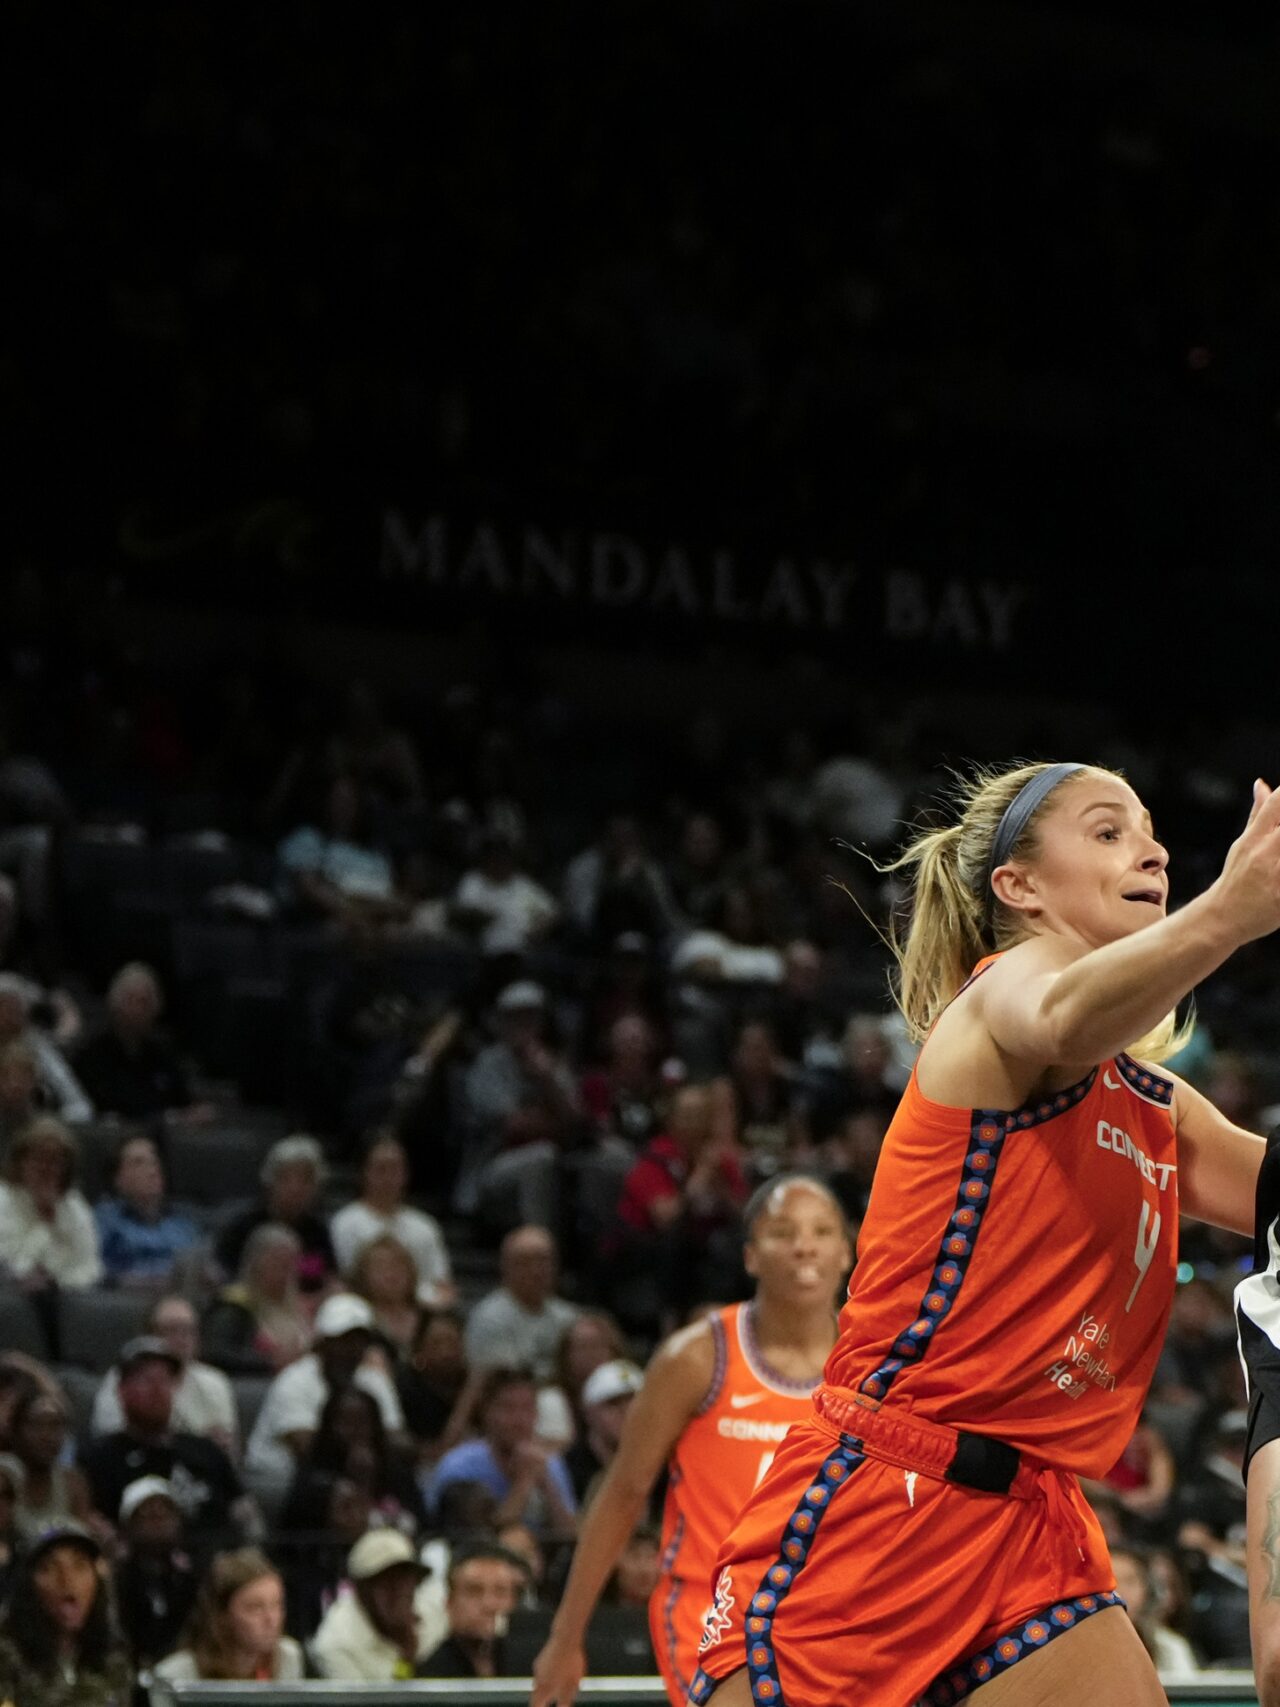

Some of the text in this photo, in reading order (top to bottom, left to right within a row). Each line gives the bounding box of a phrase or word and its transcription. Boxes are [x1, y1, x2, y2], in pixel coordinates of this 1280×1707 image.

[378, 507, 1028, 650] MANDALAY BAY
[1077, 1311, 1110, 1349] Yale
